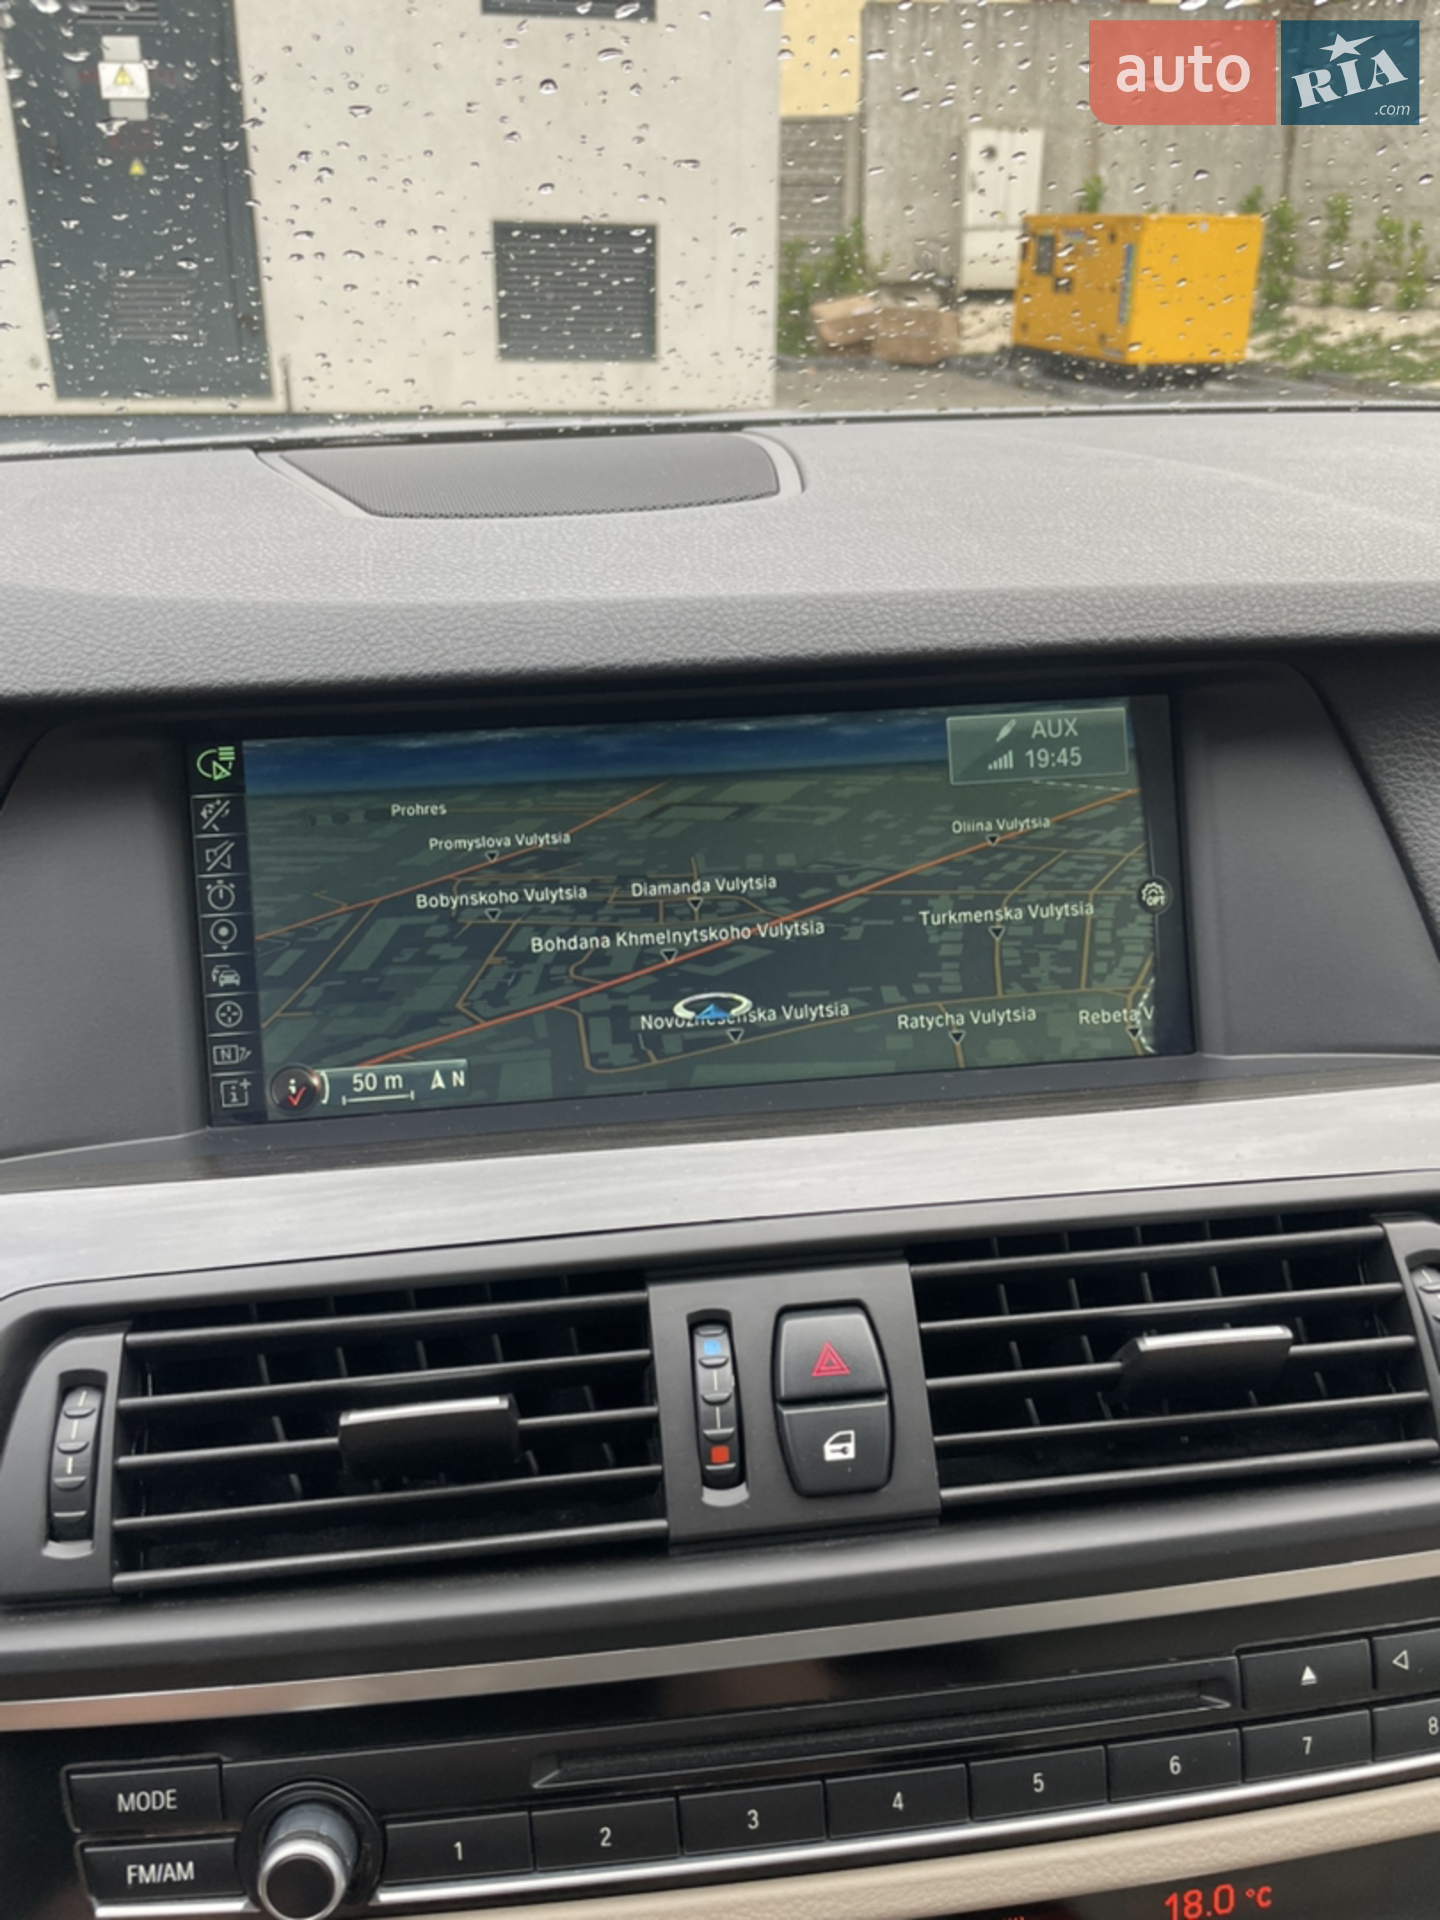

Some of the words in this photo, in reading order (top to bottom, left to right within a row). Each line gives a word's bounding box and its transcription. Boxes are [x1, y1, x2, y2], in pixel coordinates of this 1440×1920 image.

[1030, 718, 1078, 739] AUX
[1025, 747, 1082, 769] 19:45
[391, 803, 447, 817] Prohres
[996, 816, 1051, 833] Vulytsia
[429, 835, 511, 851] Promyslova
[515, 832, 571, 848] Vulytsia
[416, 888, 519, 910] Bobynskoho
[523, 885, 587, 904] Vulytsia
[631, 879, 711, 899] Diamanda
[715, 875, 777, 894] Vulytsia
[919, 907, 1023, 927] Turkmenska
[1027, 902, 1094, 922] Vulytsia
[531, 933, 610, 954] Bohdana
[616, 926, 752, 949] Khmelnytskoho
[757, 921, 825, 942] Vulytsia
[781, 1003, 850, 1022] Vulytsia
[898, 1013, 966, 1035] Ratycha
[969, 1008, 1037, 1029] Vulytsia
[353, 1072, 377, 1092] 50
[385, 1074, 403, 1090] m
[453, 1071, 466, 1087] N
[1428, 1716, 1439, 1735] 8
[1302, 1737, 1315, 1755] 7
[1168, 1755, 1182, 1776] 6
[1032, 1772, 1045, 1793] 5
[117, 1789, 178, 1813] MODE
[892, 1792, 905, 1811] 4
[747, 1809, 760, 1830] 3
[599, 1826, 612, 1847] 2
[453, 1841, 463, 1861] 1
[126, 1861, 195, 1886] FM/AM
[1164, 1884, 1235, 1920] 18.0
